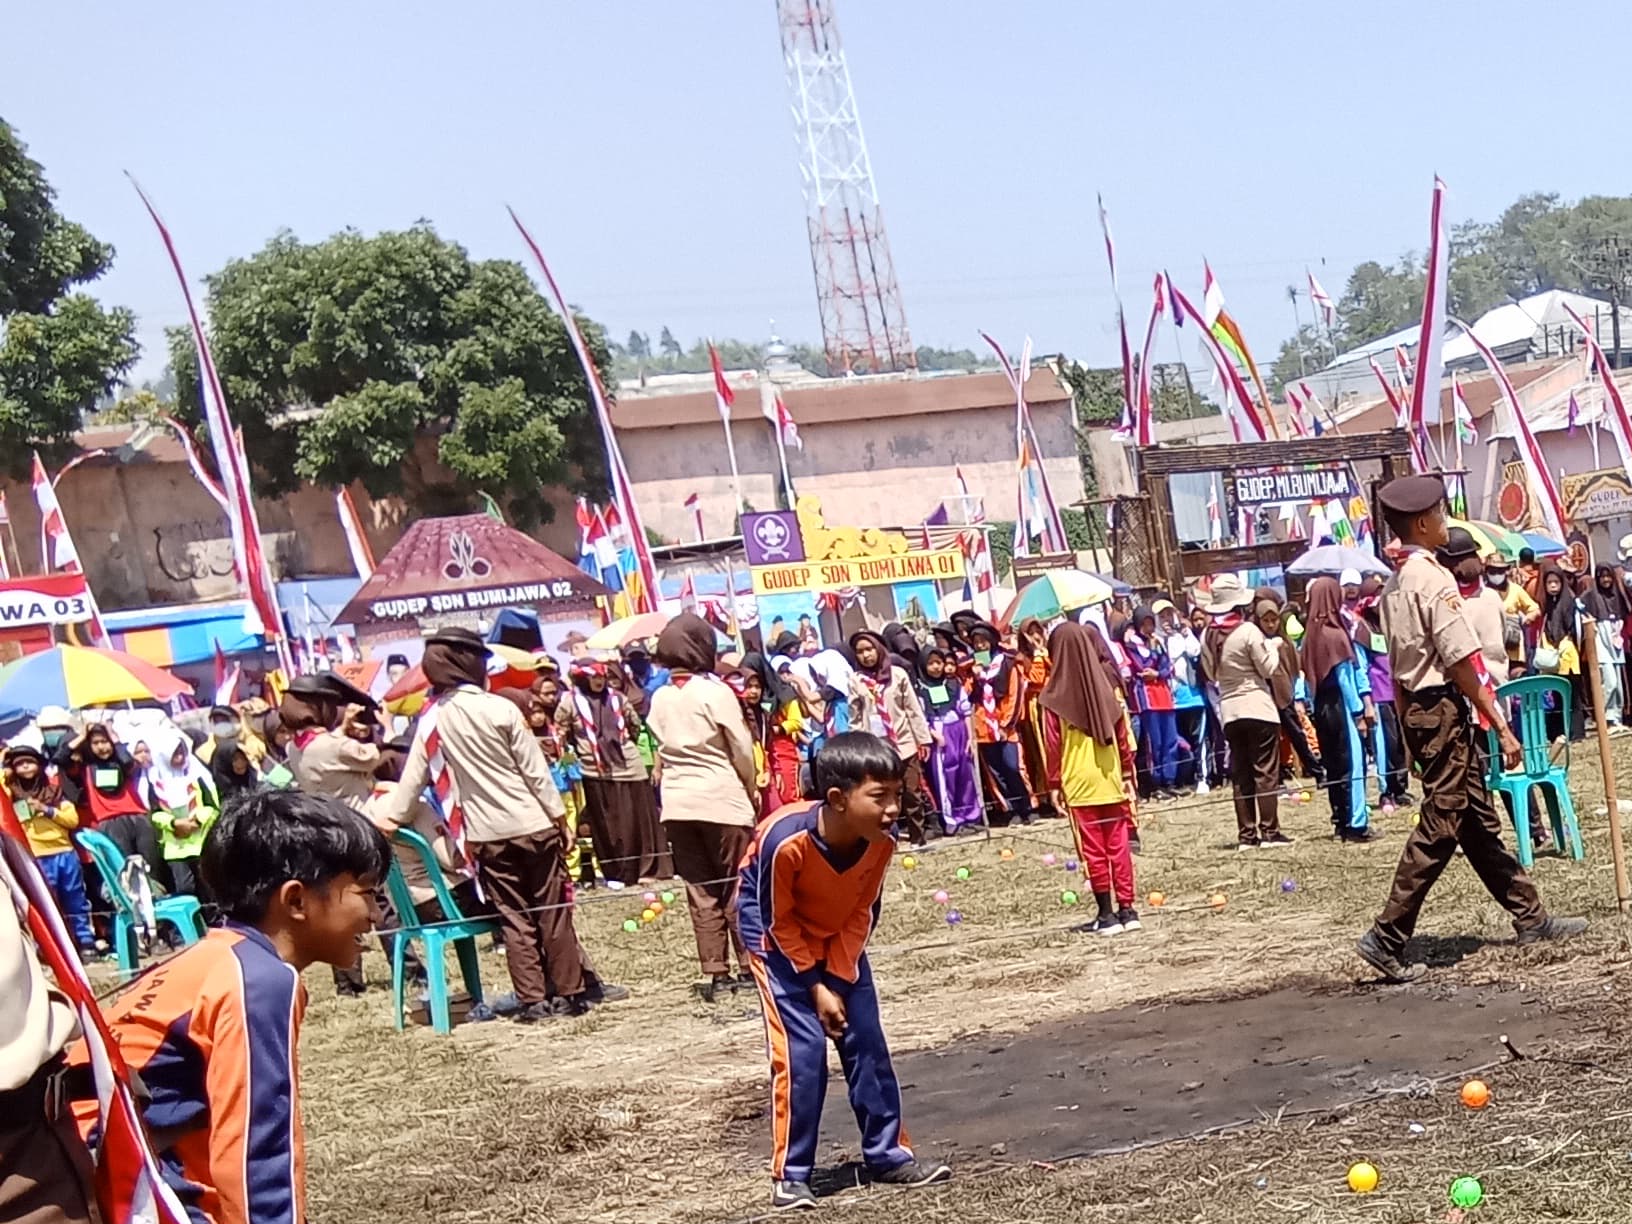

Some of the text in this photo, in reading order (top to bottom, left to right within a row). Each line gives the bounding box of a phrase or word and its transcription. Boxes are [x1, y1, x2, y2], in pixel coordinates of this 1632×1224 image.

[762, 555, 956, 590] GUDEP SDN BUMIJAWA 01
[54, 598, 86, 615] 03
[373, 581, 573, 618] GUDEP SDN BUMIJAWA 02
